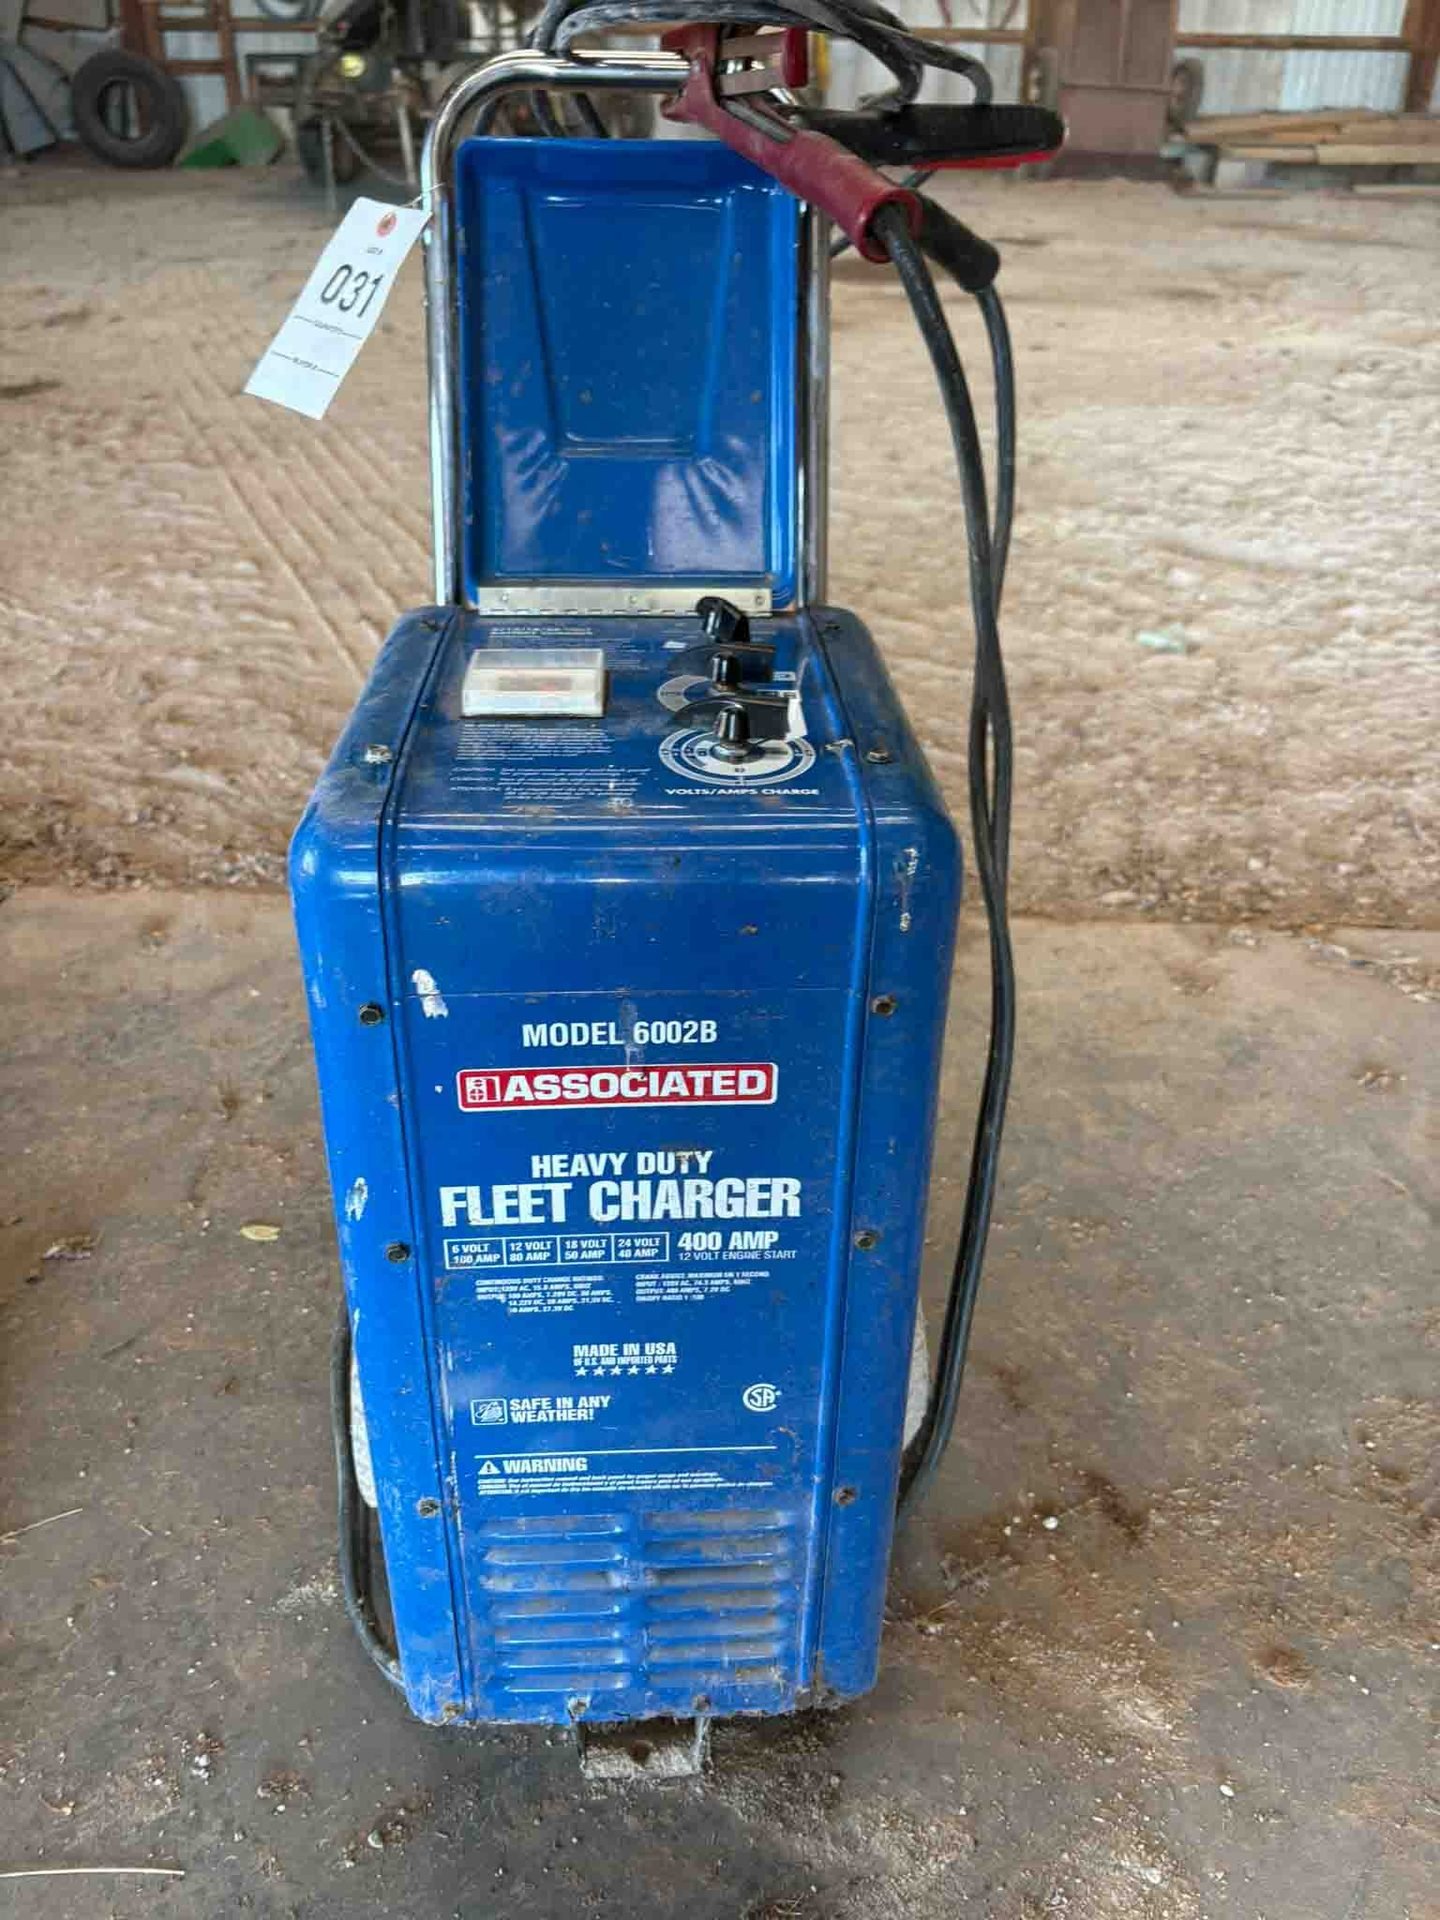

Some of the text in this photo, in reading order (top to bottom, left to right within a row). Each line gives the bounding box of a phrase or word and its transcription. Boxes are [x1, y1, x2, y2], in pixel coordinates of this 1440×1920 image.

[321, 264, 383, 318] 031
[665, 788, 820, 796] VOLTS/AMPS CHARGE
[522, 1020, 718, 1047] MODEL 6002B
[503, 1070, 767, 1101] ASSOCIATED
[531, 1151, 713, 1179] HEAVY DUTY
[438, 1177, 802, 1228] FLEET CHARGER
[510, 1241, 553, 1251] 12 VOLT
[579, 1239, 607, 1249] VOLT
[618, 1237, 661, 1247] 24 VOLT
[678, 1230, 779, 1251] 400 AMP
[462, 1243, 490, 1253] VOLT
[618, 1248, 659, 1258] 40 AMP
[453, 1254, 501, 1265] 100 AMP
[509, 1252, 551, 1262] 80 AMP
[564, 1250, 605, 1260] 50 AMP
[679, 1249, 798, 1261] 12 VOLT ENGINE START
[573, 1342, 677, 1357] MADE IN USA
[510, 1395, 611, 1411] SAFE IN ANY
[510, 1408, 595, 1423] WEATHER!
[502, 1457, 588, 1474] WARNING
